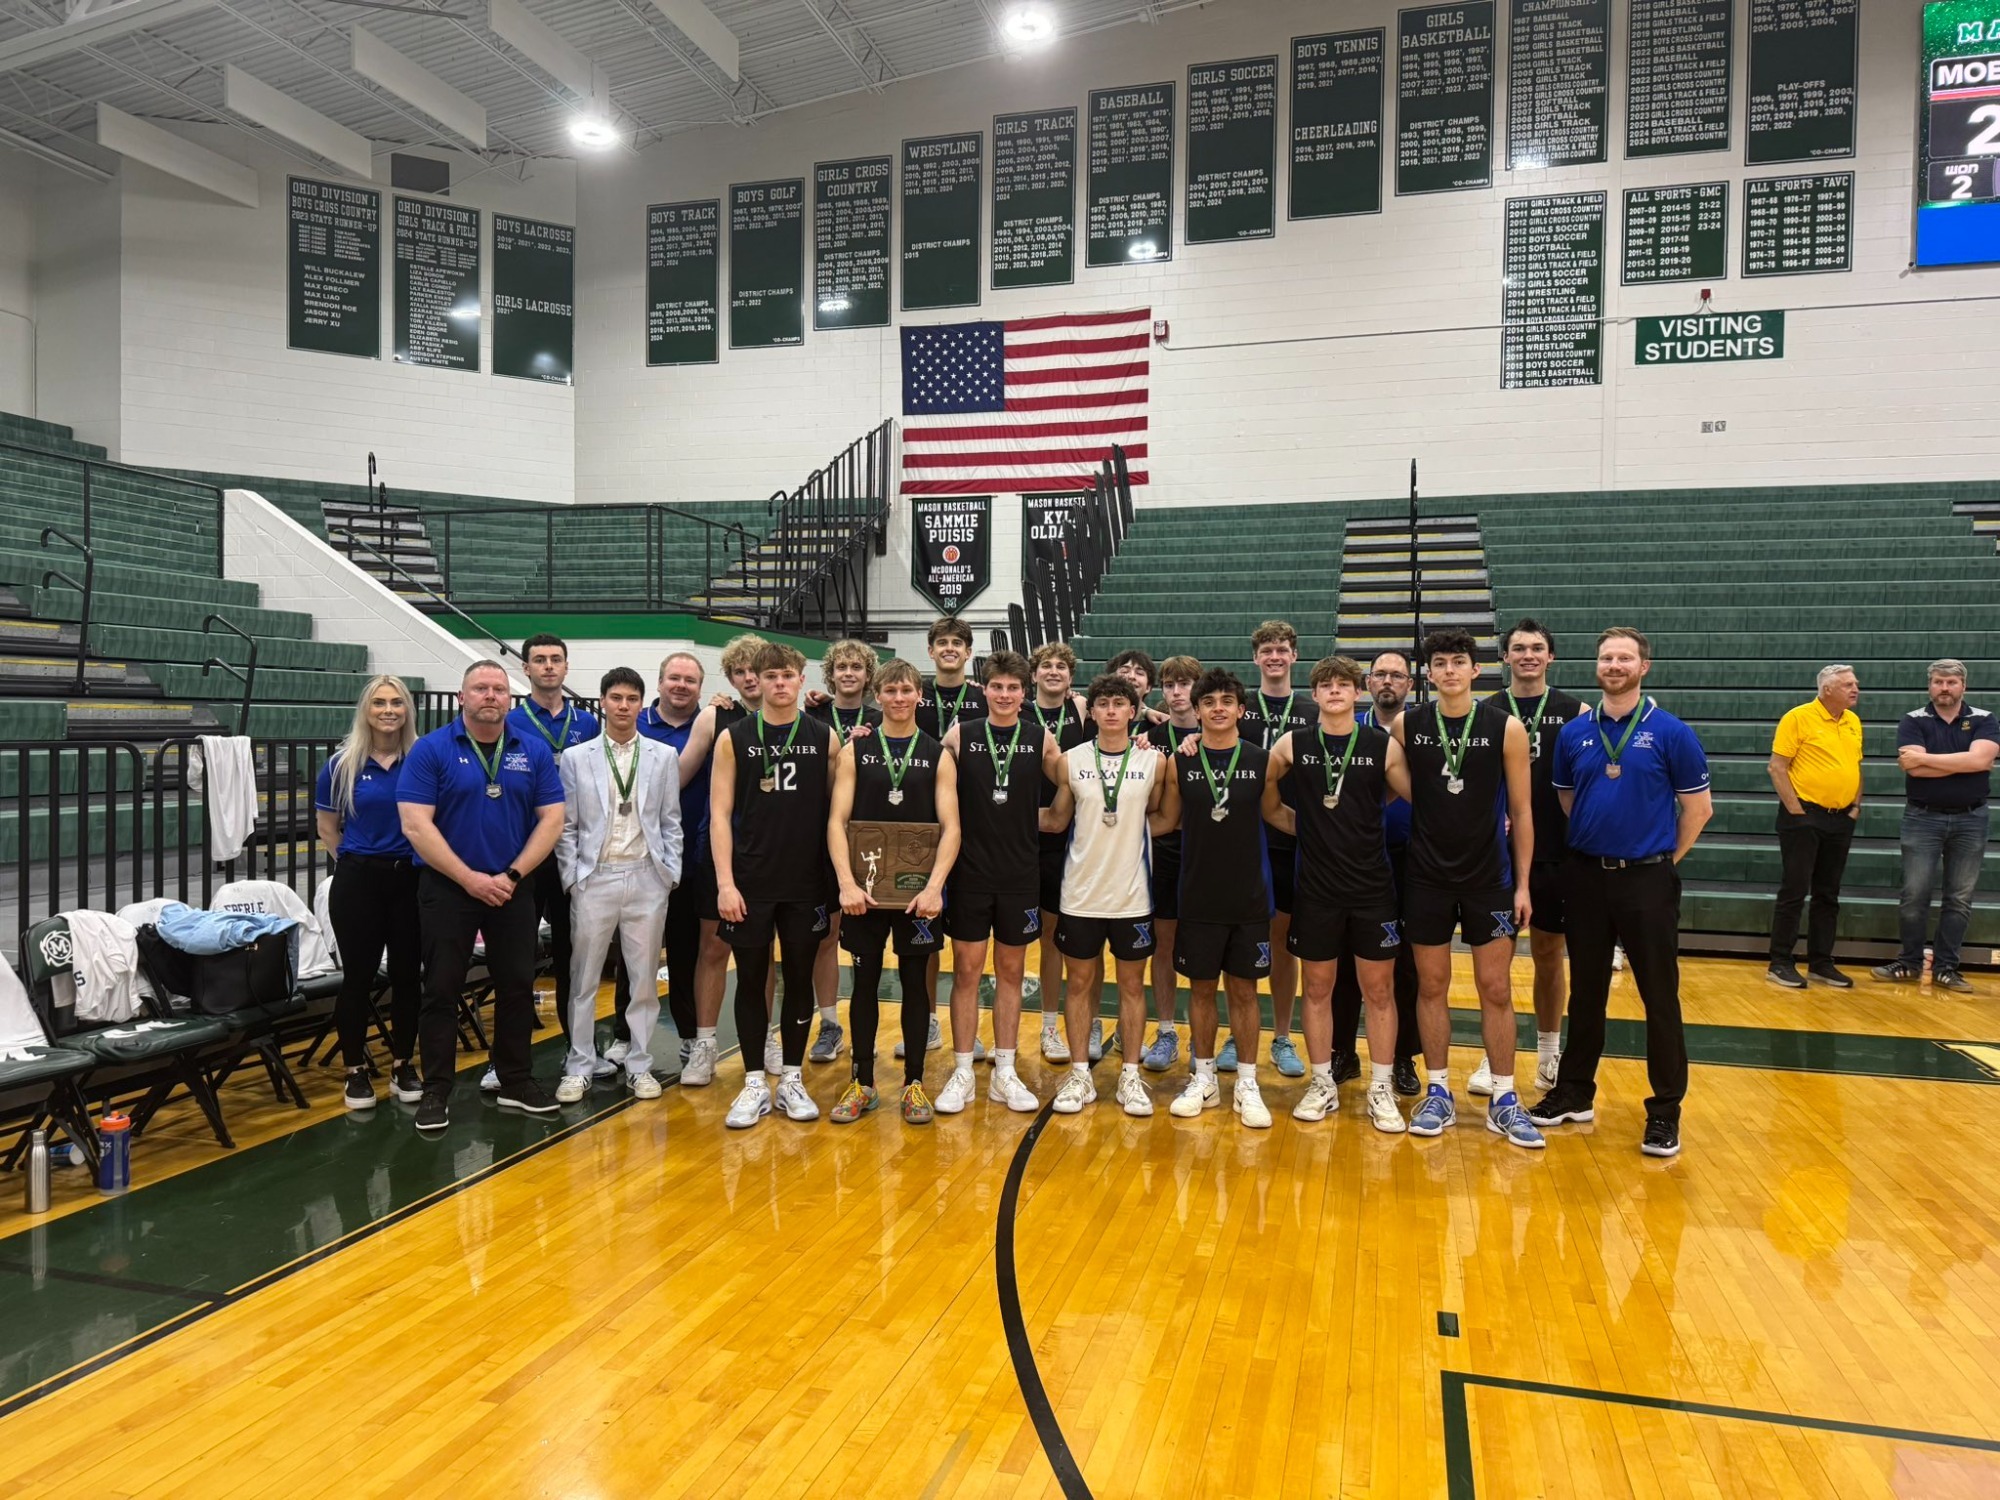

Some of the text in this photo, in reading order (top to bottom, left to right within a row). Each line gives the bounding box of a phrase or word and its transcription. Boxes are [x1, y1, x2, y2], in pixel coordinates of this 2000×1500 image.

[1426, 11, 1464, 28] GIRLS
[1401, 26, 1491, 49] BASKETBALL
[1652, 25, 1703, 37] WRESTLING
[1297, 37, 1379, 59] BOYS TENNIS
[1191, 65, 1274, 85] GIRLS SOCCER
[1777, 80, 1826, 91] PLAY-OFFS
[1100, 91, 1164, 110] BASEBALL
[1535, 97, 1578, 107] SOFTBALL
[996, 115, 1074, 135] GIRLS TRACK
[1410, 117, 1480, 130] DISTRICT CHAMPS
[1629, 116, 1703, 129] 2024 BASEBALL
[1295, 120, 1377, 141] CHEERLEADING
[909, 141, 976, 158] WRESTLING
[817, 164, 888, 182] GIRLS CROSS
[1197, 169, 1263, 182] DISTRICT CHAMPS
[827, 181, 878, 197] COUNTRY
[1750, 182, 1769, 193] ALL
[1774, 179, 1814, 192] SPORTS
[1823, 176, 1848, 188] FAVC
[1951, 175, 1972, 199] 2
[293, 182, 317, 196] OHIO
[322, 187, 368, 205] DIVISION
[738, 187, 796, 203] BOYS GOLF
[1099, 192, 1161, 204] DISTRICT CHAMPS
[1631, 192, 1649, 203] ALL
[1654, 189, 1692, 201] SPORTS
[1700, 186, 1721, 198] GMC
[292, 196, 376, 221] BOYS CROSS COUNTRY
[398, 201, 421, 215] OHIO
[425, 206, 469, 223] DIVISION
[651, 208, 716, 223] BOYS TRACK
[310, 213, 333, 225] STATE
[335, 217, 377, 232] RUNNER-UP
[398, 215, 419, 228] GIRLS
[422, 219, 446, 233] TRACK
[457, 225, 476, 238] FIELD
[1003, 216, 1063, 228] DISTRICT CHAMPS
[415, 231, 436, 242] STATE
[496, 218, 572, 242] BOYS LACROSSE
[912, 239, 971, 250] DISTRICT CHAMPS
[1528, 243, 1571, 252] SOFTBALL
[824, 250, 880, 260] DISTRICT CHAMPS
[304, 273, 324, 282] ALEX
[304, 282, 349, 294] MAX GRECO
[304, 291, 321, 299] MAX
[739, 288, 794, 298] DISTRICT CHAMPS
[1527, 287, 1576, 297] WRESTLING
[304, 300, 340, 310] BRENDON
[495, 294, 572, 317] GIRLS LACROSSE
[304, 308, 329, 317] JASON
[304, 317, 328, 326] JERRY
[1658, 315, 1762, 338] VISITING
[1645, 336, 1775, 361] STUDENTS
[1526, 361, 1548, 369] BOYS
[1550, 359, 1584, 368] SOCCER
[918, 502, 986, 512] MASON BASKETBALL
[1028, 498, 1052, 508] MASON
[925, 514, 978, 529] SAMMIE
[929, 529, 975, 543] PUISIS
[928, 574, 974, 583] ALL-AMERICAN
[939, 584, 962, 595] 2019
